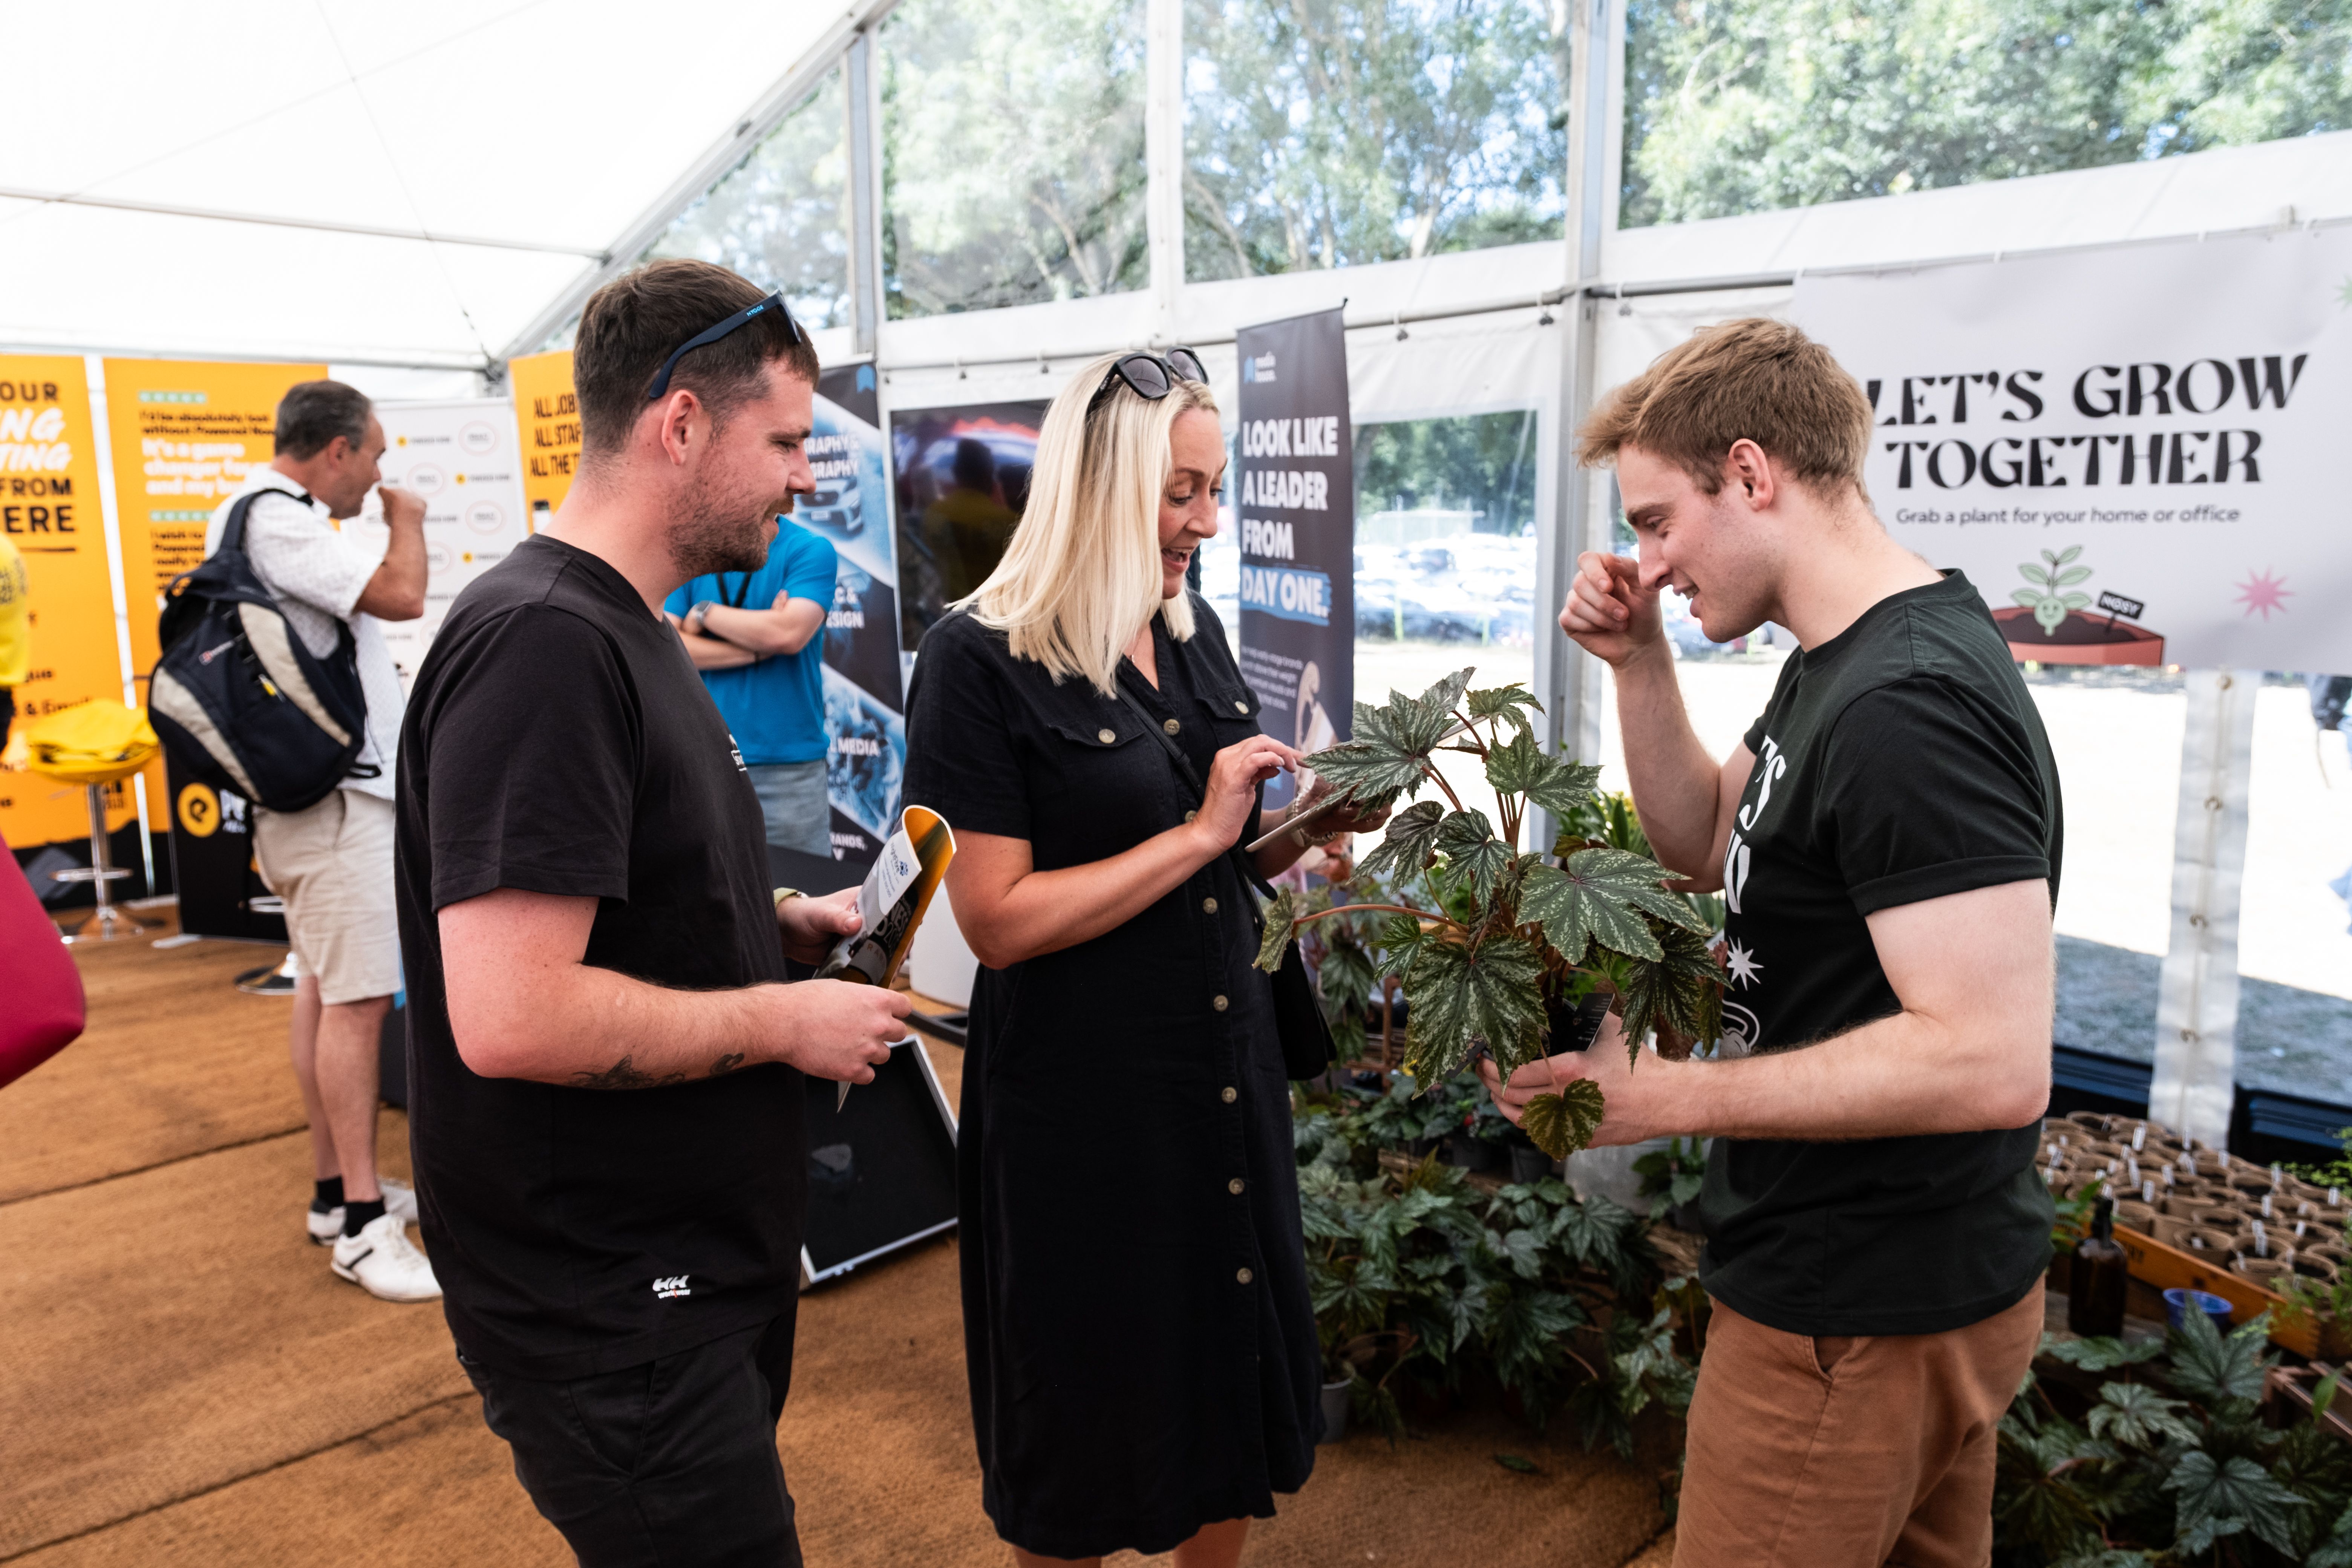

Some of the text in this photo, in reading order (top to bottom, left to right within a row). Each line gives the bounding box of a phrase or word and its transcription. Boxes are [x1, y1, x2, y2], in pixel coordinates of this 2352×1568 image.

[746, 305, 764, 317] HYGGE
[1867, 353, 2309, 427] LET'S GROW
[533, 393, 578, 419] ALL JOB
[534, 425, 553, 447] ALL
[1243, 416, 1338, 458] LOOK LIKE
[191, 443, 245, 461] game
[1885, 429, 2263, 490] TOGETHER
[143, 460, 222, 479] changer
[530, 455, 548, 477] ALL
[550, 454, 570, 476] THE
[145, 477, 183, 495] and
[1242, 470, 1329, 511] A LEADER
[5, 505, 75, 533] ERE
[1896, 503, 2240, 527] Grab a plant for your home or office
[1242, 518, 1295, 560] FROM
[846, 586, 857, 603] &
[1242, 568, 1329, 617] DAY ONE.
[2101, 594, 2141, 616] NOSY
[837, 737, 882, 757] MEDIA
